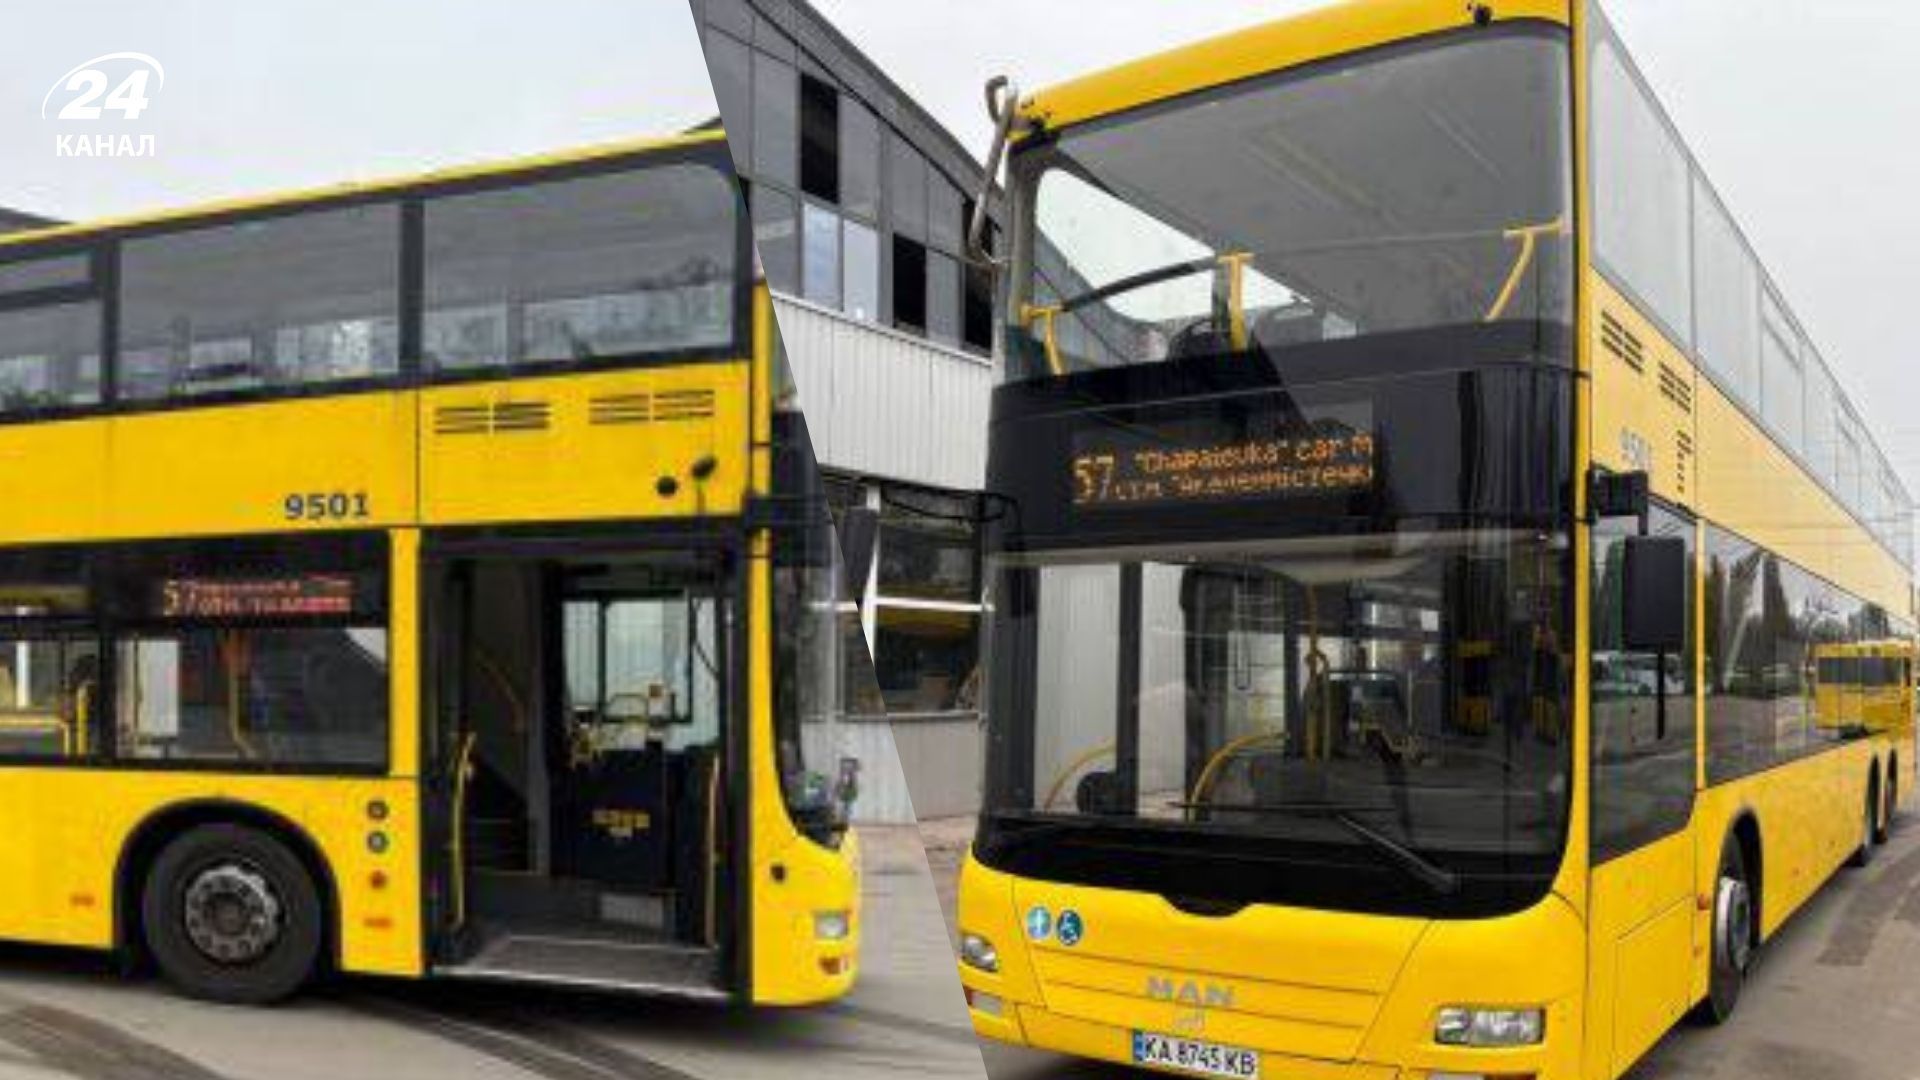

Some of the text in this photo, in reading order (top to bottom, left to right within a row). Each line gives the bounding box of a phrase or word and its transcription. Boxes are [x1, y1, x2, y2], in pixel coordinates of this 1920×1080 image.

[1073, 454, 1115, 504] 57
[284, 492, 369, 521] 9501
[1146, 974, 1237, 1008] MAN
[1145, 1036, 1256, 1076] KA 8745 KB
